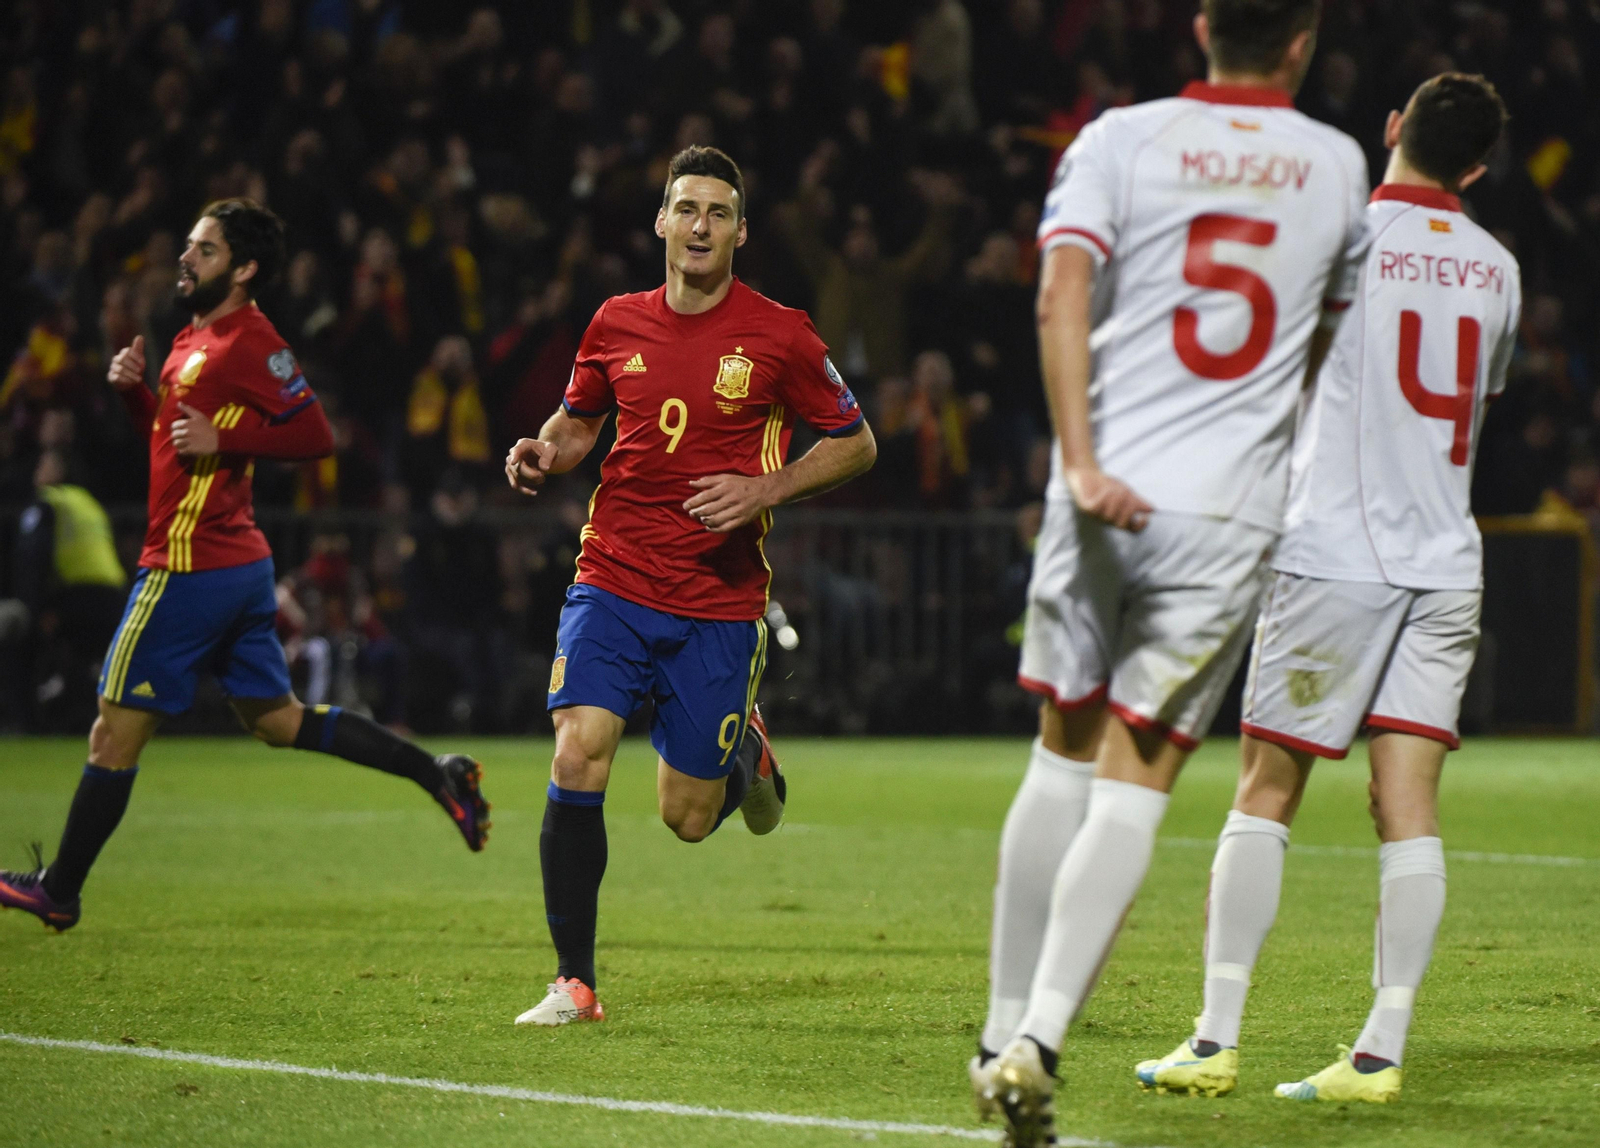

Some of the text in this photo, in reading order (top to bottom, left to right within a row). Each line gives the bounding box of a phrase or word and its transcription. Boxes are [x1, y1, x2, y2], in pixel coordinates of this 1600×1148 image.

[1181, 150, 1312, 189] MOJSOV
[1173, 213, 1278, 381] 5
[1380, 250, 1505, 295] RISTEVSKI
[623, 364, 647, 372] adidas
[1397, 309, 1480, 467] 4
[659, 398, 687, 453] 9
[718, 713, 740, 765] 9
